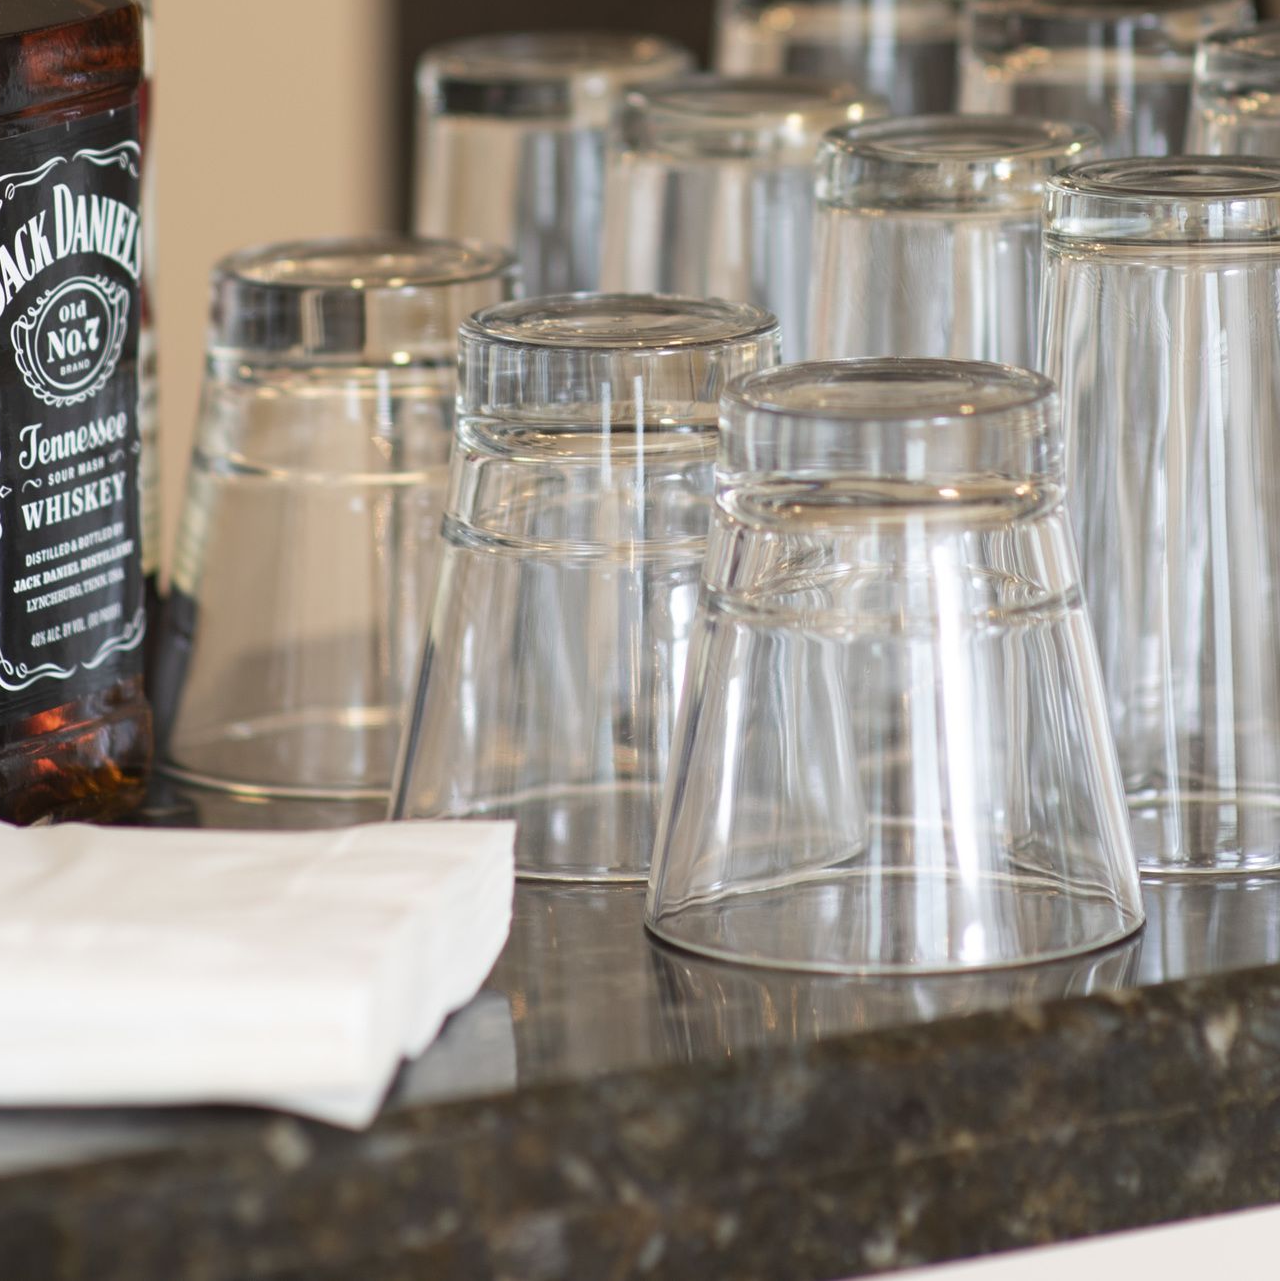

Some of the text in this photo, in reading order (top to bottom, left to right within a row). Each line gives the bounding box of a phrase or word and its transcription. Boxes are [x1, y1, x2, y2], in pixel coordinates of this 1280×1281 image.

[58, 299, 87, 323] Old
[60, 359, 91, 376] BRAND
[19, 411, 128, 470] Tennessee
[48, 455, 106, 487] SOUR MASH
[21, 471, 127, 531] WHISKEY
[25, 541, 70, 567] DISTILLED
[78, 526, 113, 550] BOTTLED
[13, 574, 42, 594] JACK
[43, 561, 80, 585] DANIEL
